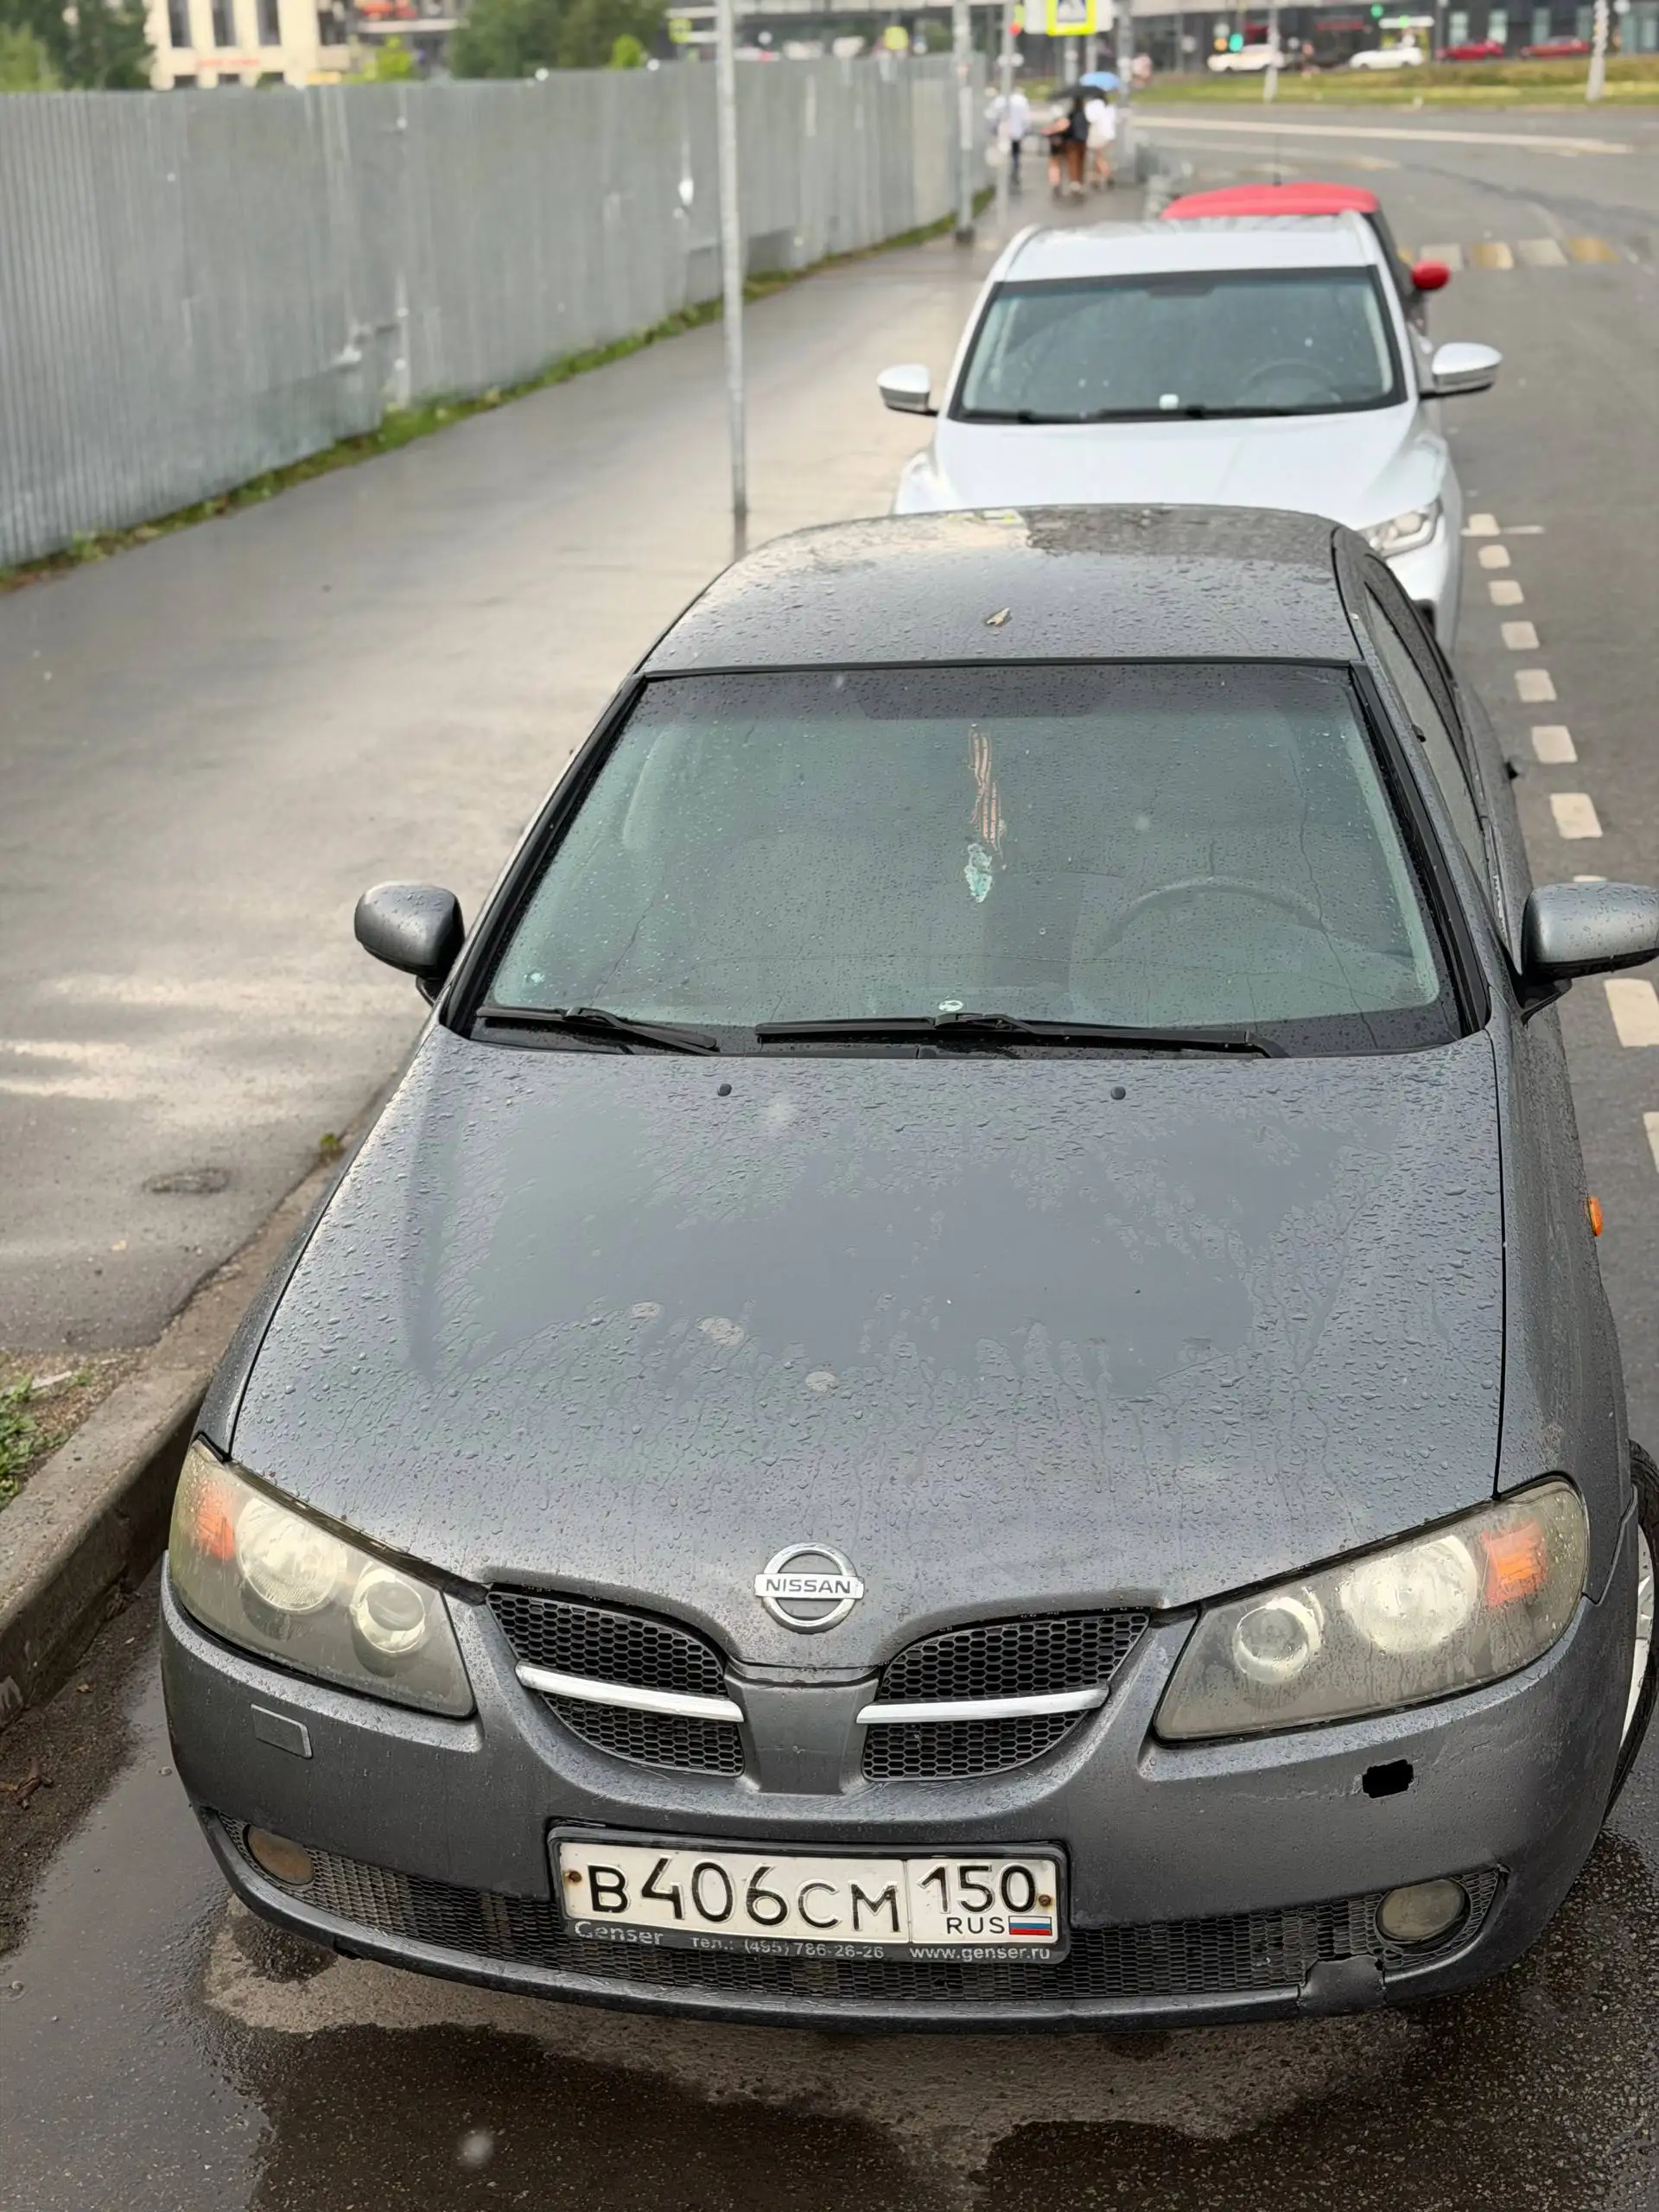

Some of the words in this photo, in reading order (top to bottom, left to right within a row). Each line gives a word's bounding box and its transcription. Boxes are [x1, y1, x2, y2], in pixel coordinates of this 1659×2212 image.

[766, 1579, 850, 1594] NISSAN
[920, 1865, 1036, 1913] 150
[946, 1916, 1005, 1935] RUS
[909, 1947, 1051, 1962] www.genser.ru
